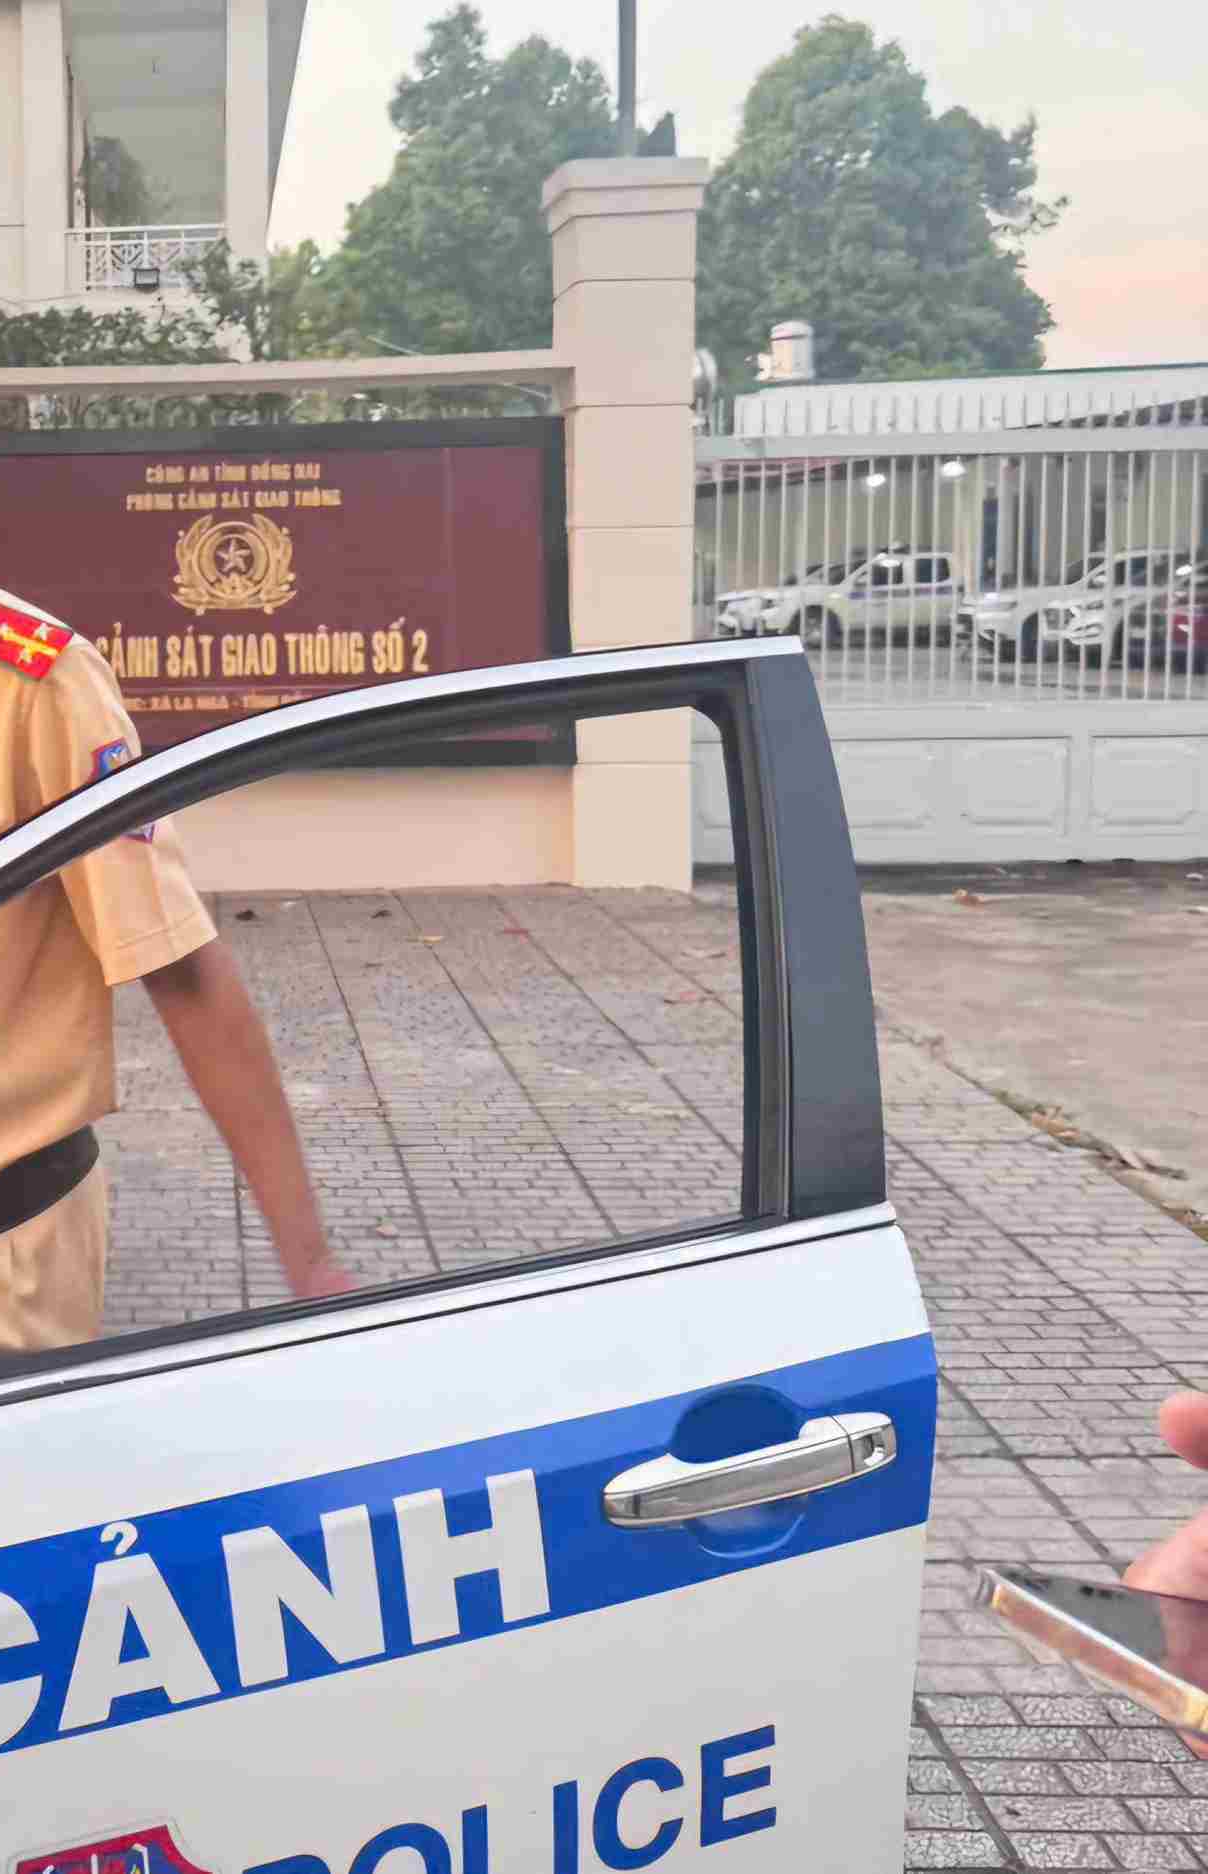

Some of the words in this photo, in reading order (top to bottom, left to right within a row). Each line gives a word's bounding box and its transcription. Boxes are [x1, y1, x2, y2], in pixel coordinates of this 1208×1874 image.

[189, 465, 210, 482] AN
[221, 488, 249, 508] SÁT
[166, 625, 214, 677] SÁT
[221, 632, 277, 677] GIAO
[284, 625, 365, 675] THÔNG
[372, 616, 405, 675] SỐ
[412, 629, 428, 673] 2
[242, 1724, 777, 1874] ICE
